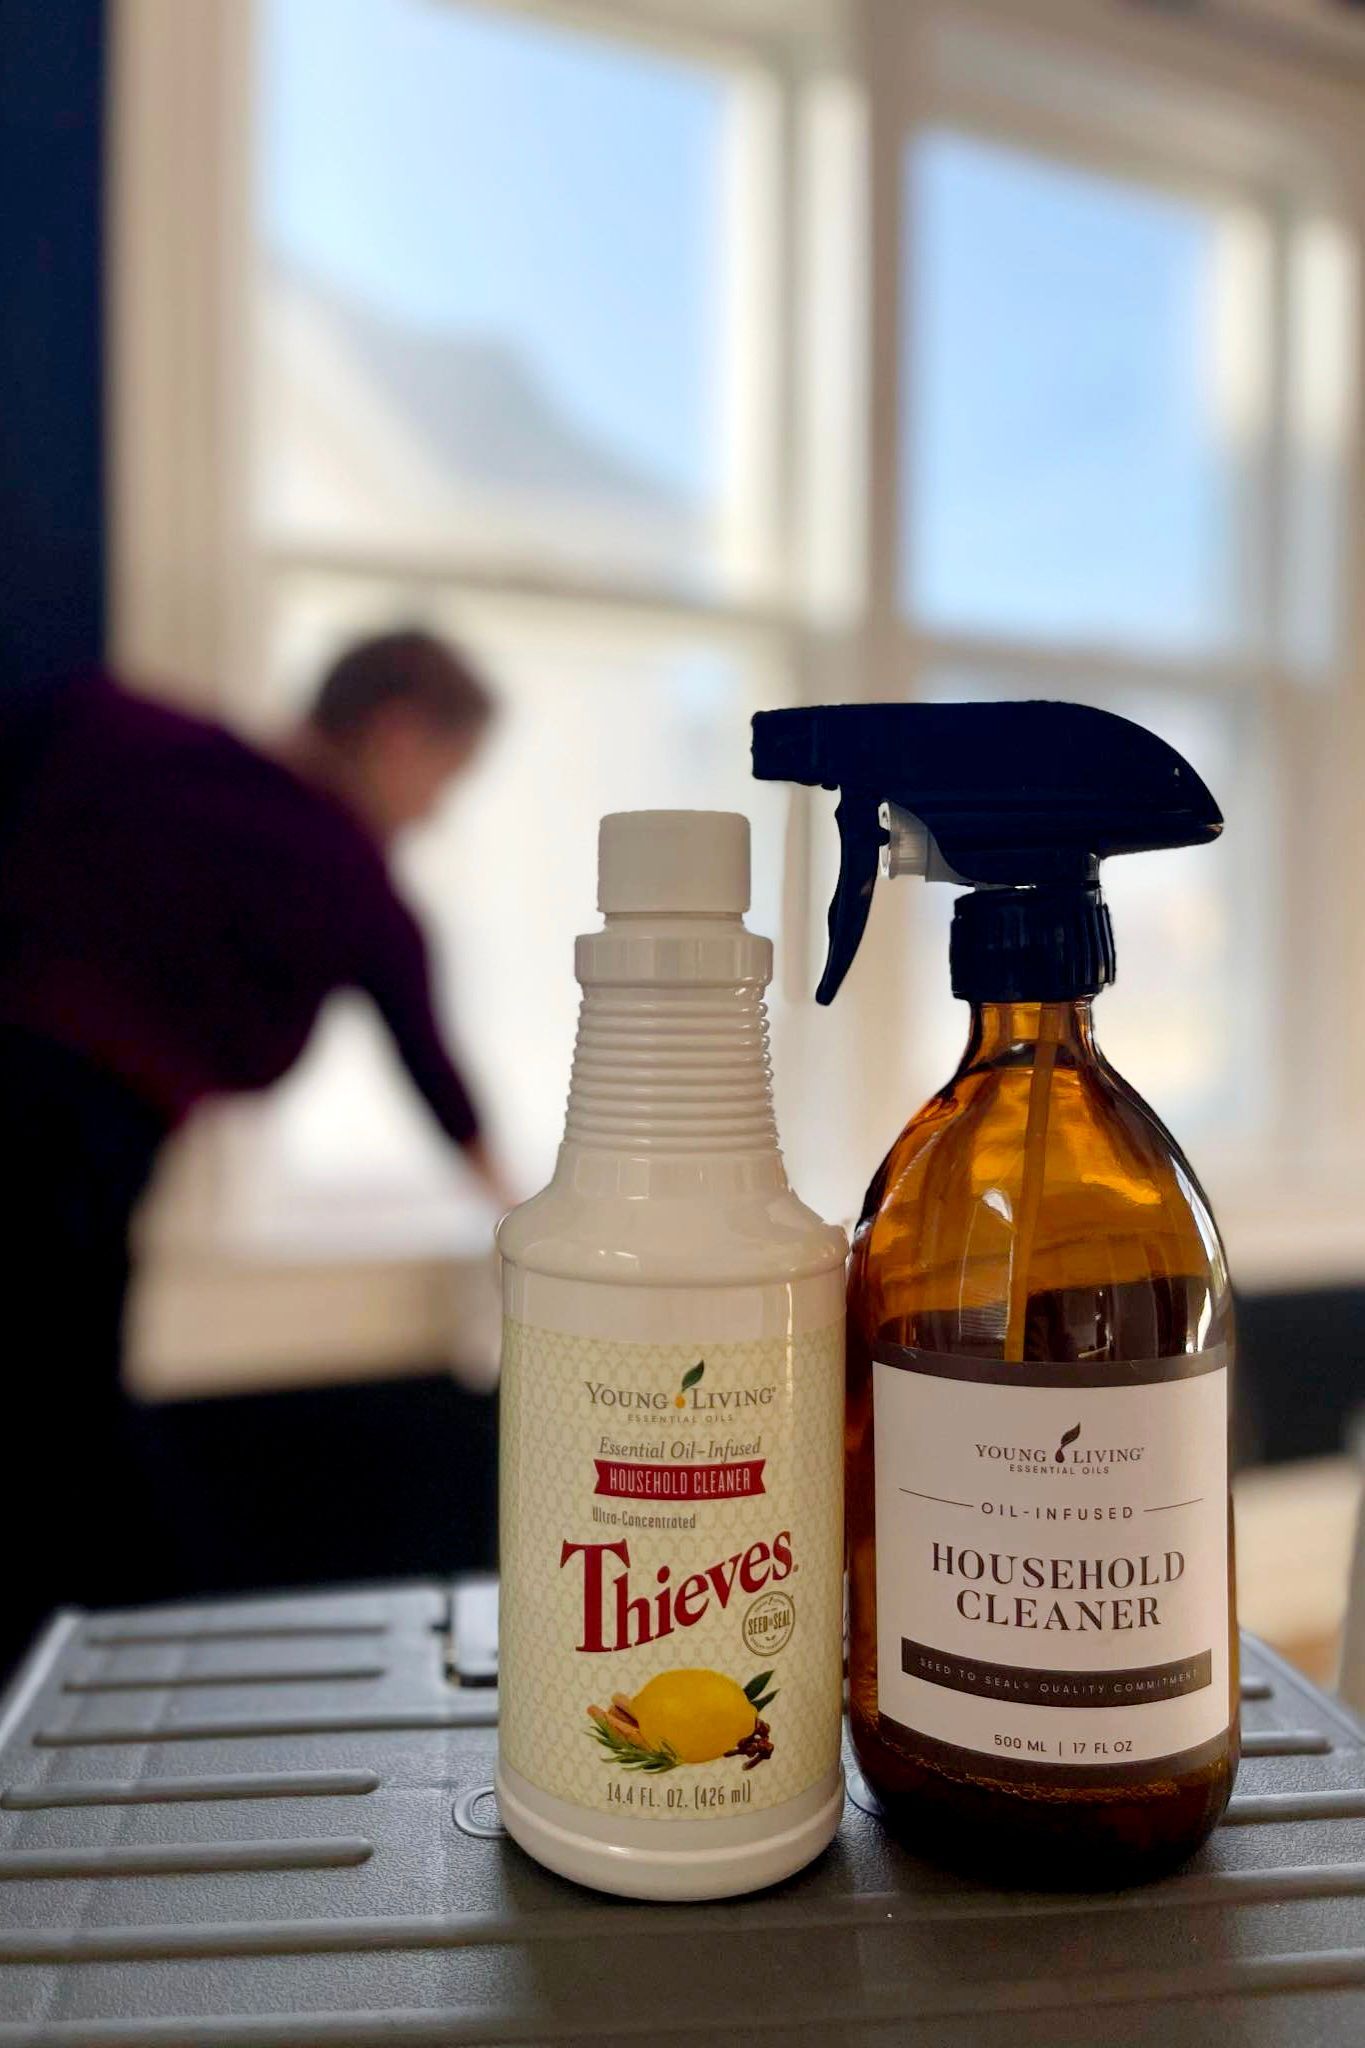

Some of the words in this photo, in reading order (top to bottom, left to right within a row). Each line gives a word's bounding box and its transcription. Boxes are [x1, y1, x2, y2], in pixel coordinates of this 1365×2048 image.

[584, 1381, 669, 1409] YOUNG
[628, 1414, 697, 1423] ESSENTIAL
[706, 1414, 733, 1423] OILS
[599, 1436, 665, 1459] Essential
[671, 1436, 762, 1463] Oil-Infused
[975, 1444, 1047, 1463] YOUNG
[610, 1468, 688, 1495] HOUSEHOLD
[693, 1467, 750, 1494] CLEANER
[1009, 1464, 1075, 1475] ESSENTIAL
[1082, 1466, 1110, 1475] OILS
[592, 1506, 696, 1529] Ultra-Concentrated
[981, 1502, 1133, 1521] OIL-INFUSED
[931, 1542, 1185, 1590] HOUSEHOLD
[560, 1530, 793, 1653] Thieves
[748, 1615, 768, 1636] SEED
[773, 1609, 791, 1630] SEAL
[956, 1589, 1162, 1631] CLEANER
[920, 1657, 950, 1675] SEED
[959, 1670, 977, 1682] TO
[1039, 1683, 1105, 1695] QUALITY
[1113, 1669, 1198, 1693] COMMITMENT
[994, 1734, 1022, 1750] 500
[1027, 1740, 1047, 1753] ML
[1073, 1742, 1086, 1755] 17
[1094, 1742, 1109, 1754] FL
[1113, 1740, 1133, 1753] OZ
[607, 1782, 633, 1805] 14.4
[640, 1786, 661, 1808] FL.
[667, 1788, 688, 1809] OZ.
[694, 1785, 725, 1810] (426
[731, 1779, 751, 1803] ml)
